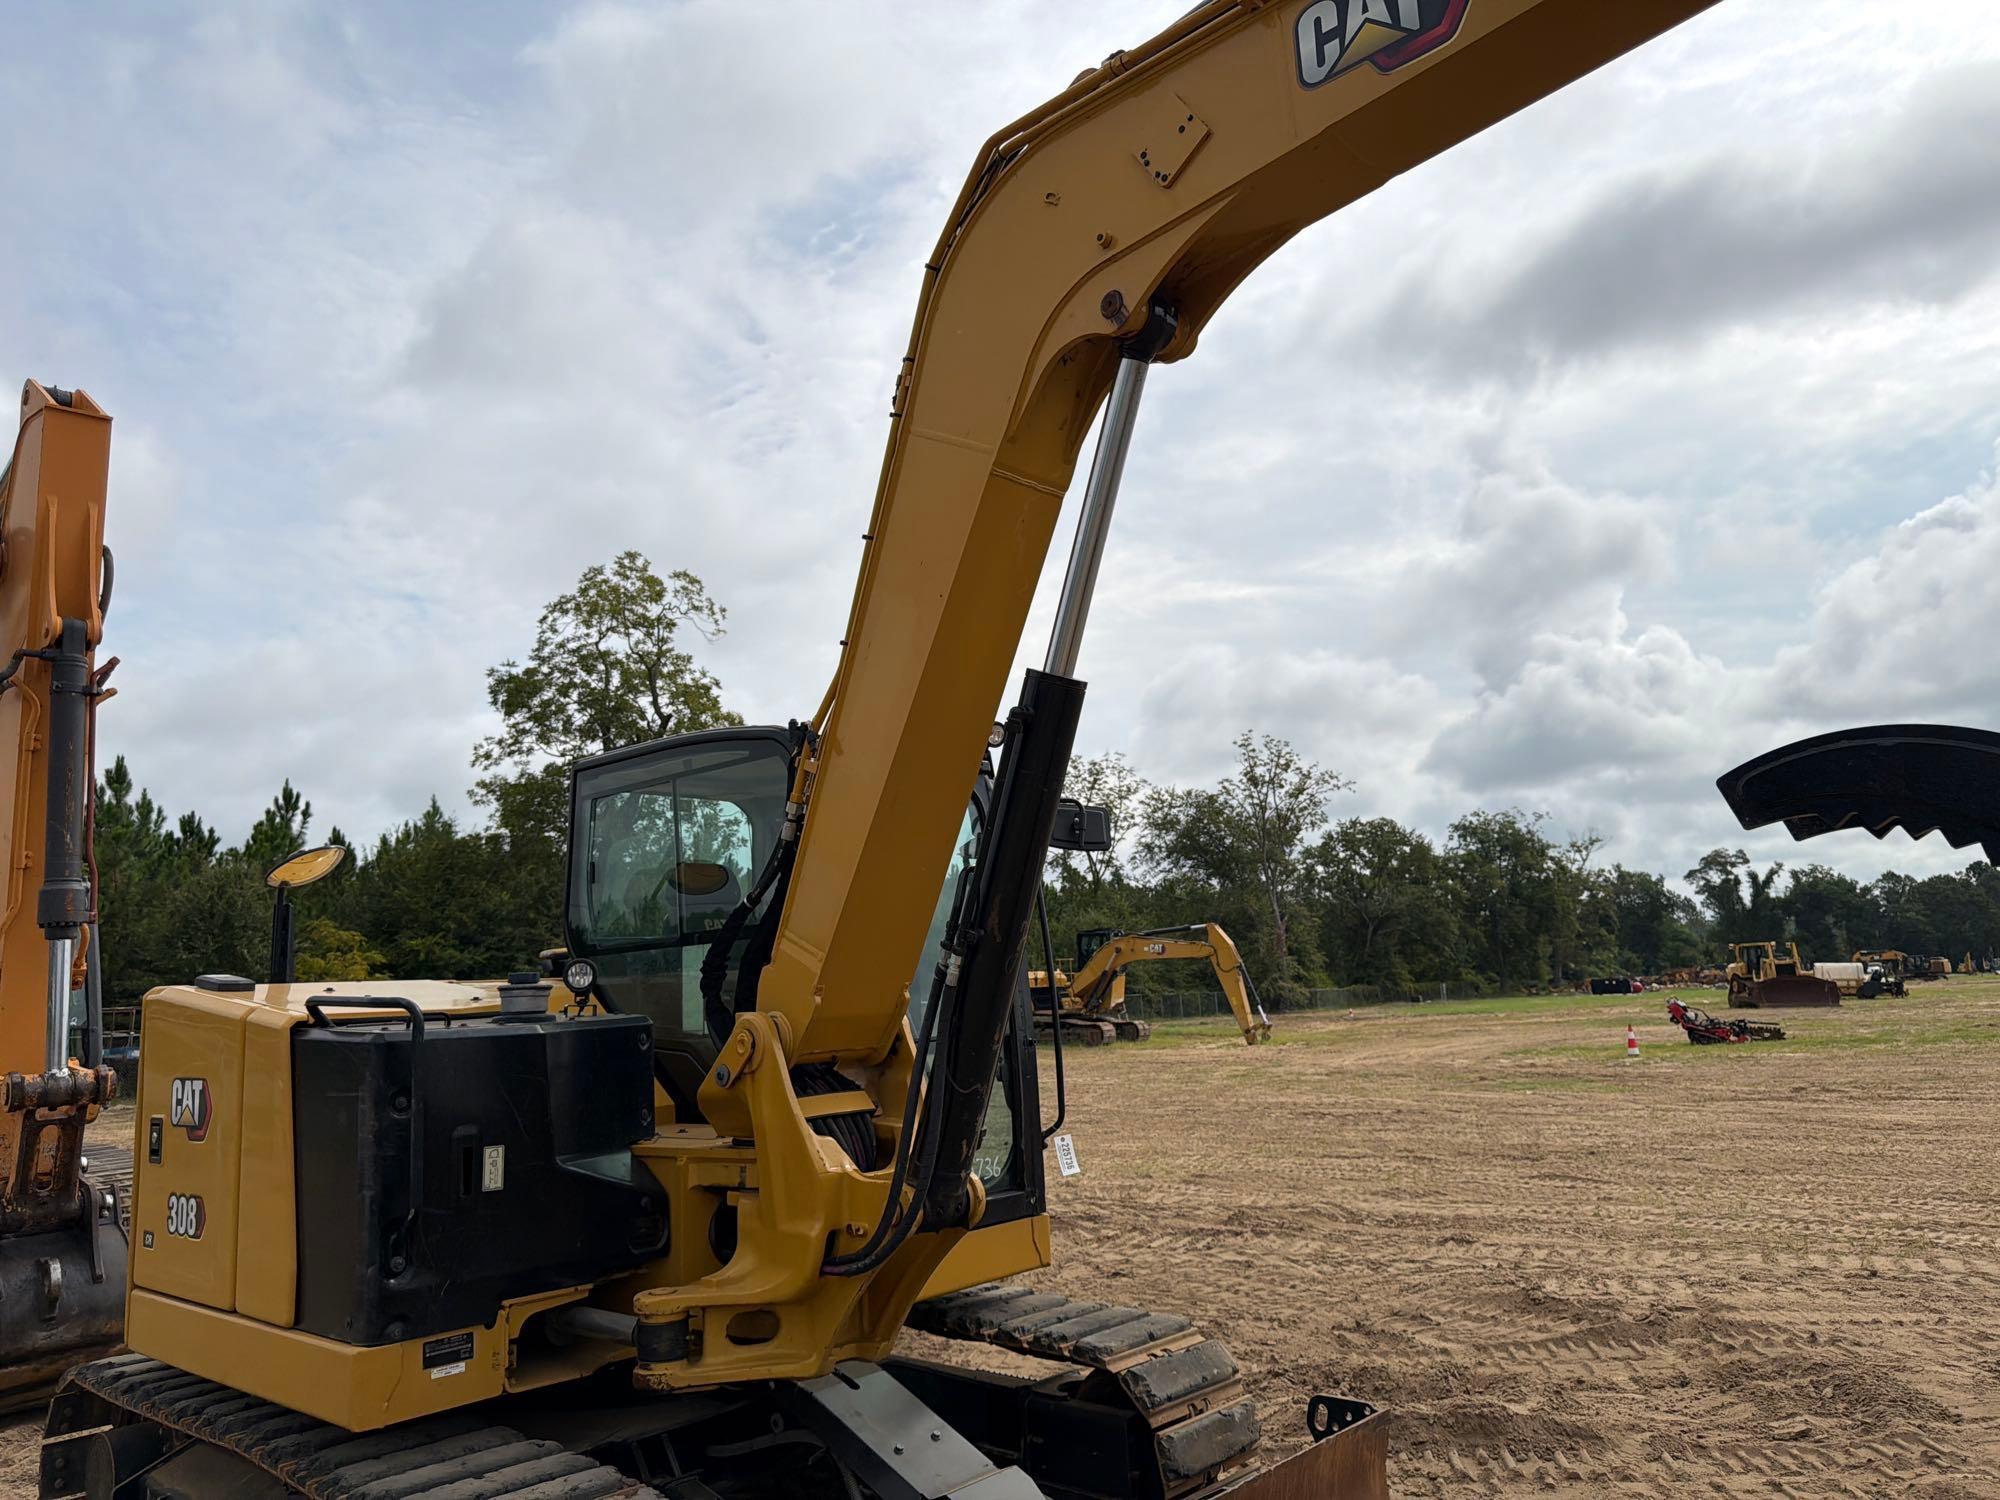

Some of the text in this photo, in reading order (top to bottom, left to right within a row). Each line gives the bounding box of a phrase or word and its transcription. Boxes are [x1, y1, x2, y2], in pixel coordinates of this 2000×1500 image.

[172, 1079, 203, 1126] CAT
[971, 1156, 1001, 1180] 736
[1061, 1142, 1075, 1170] 225736
[168, 1195, 197, 1236] 308
